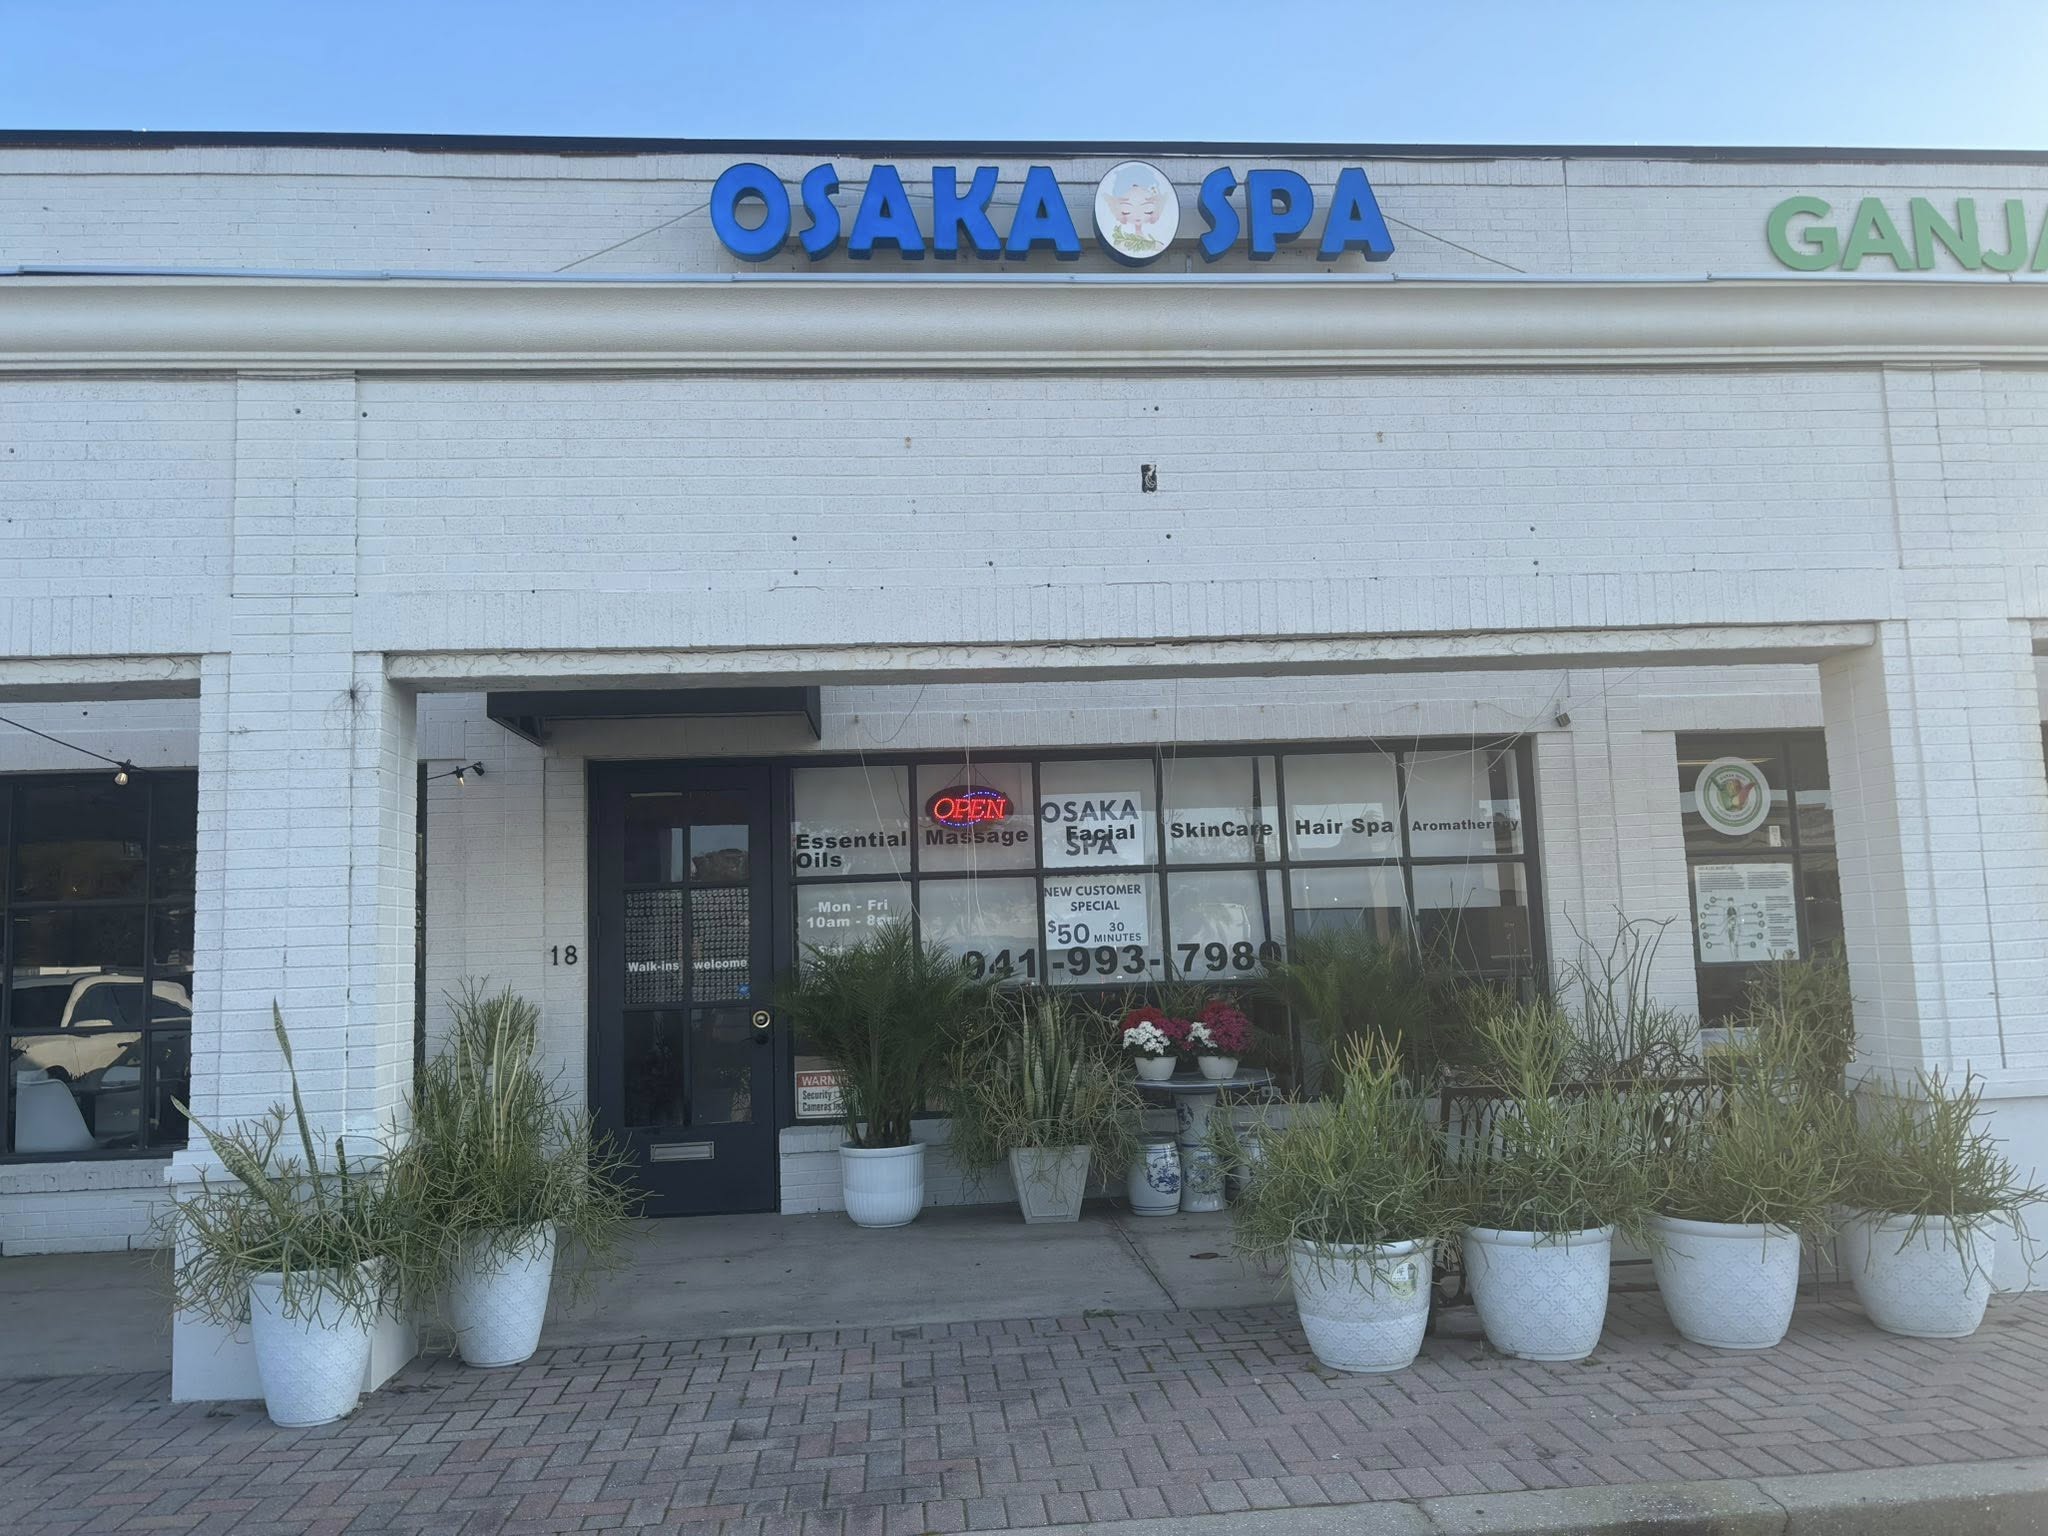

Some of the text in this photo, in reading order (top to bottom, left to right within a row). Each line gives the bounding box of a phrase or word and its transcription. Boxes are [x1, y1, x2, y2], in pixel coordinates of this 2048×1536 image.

[710, 162, 1395, 263] OSAKA SPA
[1766, 195, 2048, 271] GANJ
[934, 797, 1006, 819] OPEN
[1041, 799, 1139, 823] OSAKA
[1066, 824, 1135, 841] Facial
[1170, 820, 1273, 838] SkinCare
[1295, 818, 1394, 838] Hair Spa
[1412, 819, 1519, 832] Aromathery
[796, 831, 907, 849] Essential
[926, 829, 1029, 847] Massage
[1065, 834, 1118, 856] SPA
[796, 852, 842, 868] Oils
[1044, 884, 1141, 897] NEW CUSTOMER
[818, 901, 851, 913] Mon
[867, 899, 888, 911] Fri
[1070, 900, 1120, 912] SPECIAL
[806, 917, 850, 929] 10am
[1109, 922, 1125, 932] 30
[1048, 920, 1090, 944] $50
[1094, 933, 1142, 943] MINUTES
[551, 945, 578, 966] 18
[628, 958, 748, 972] Walk-ins welcome
[802, 1075, 850, 1086] WARN
[803, 1090, 832, 1101] Security
[803, 1101, 831, 1112] Cameras
